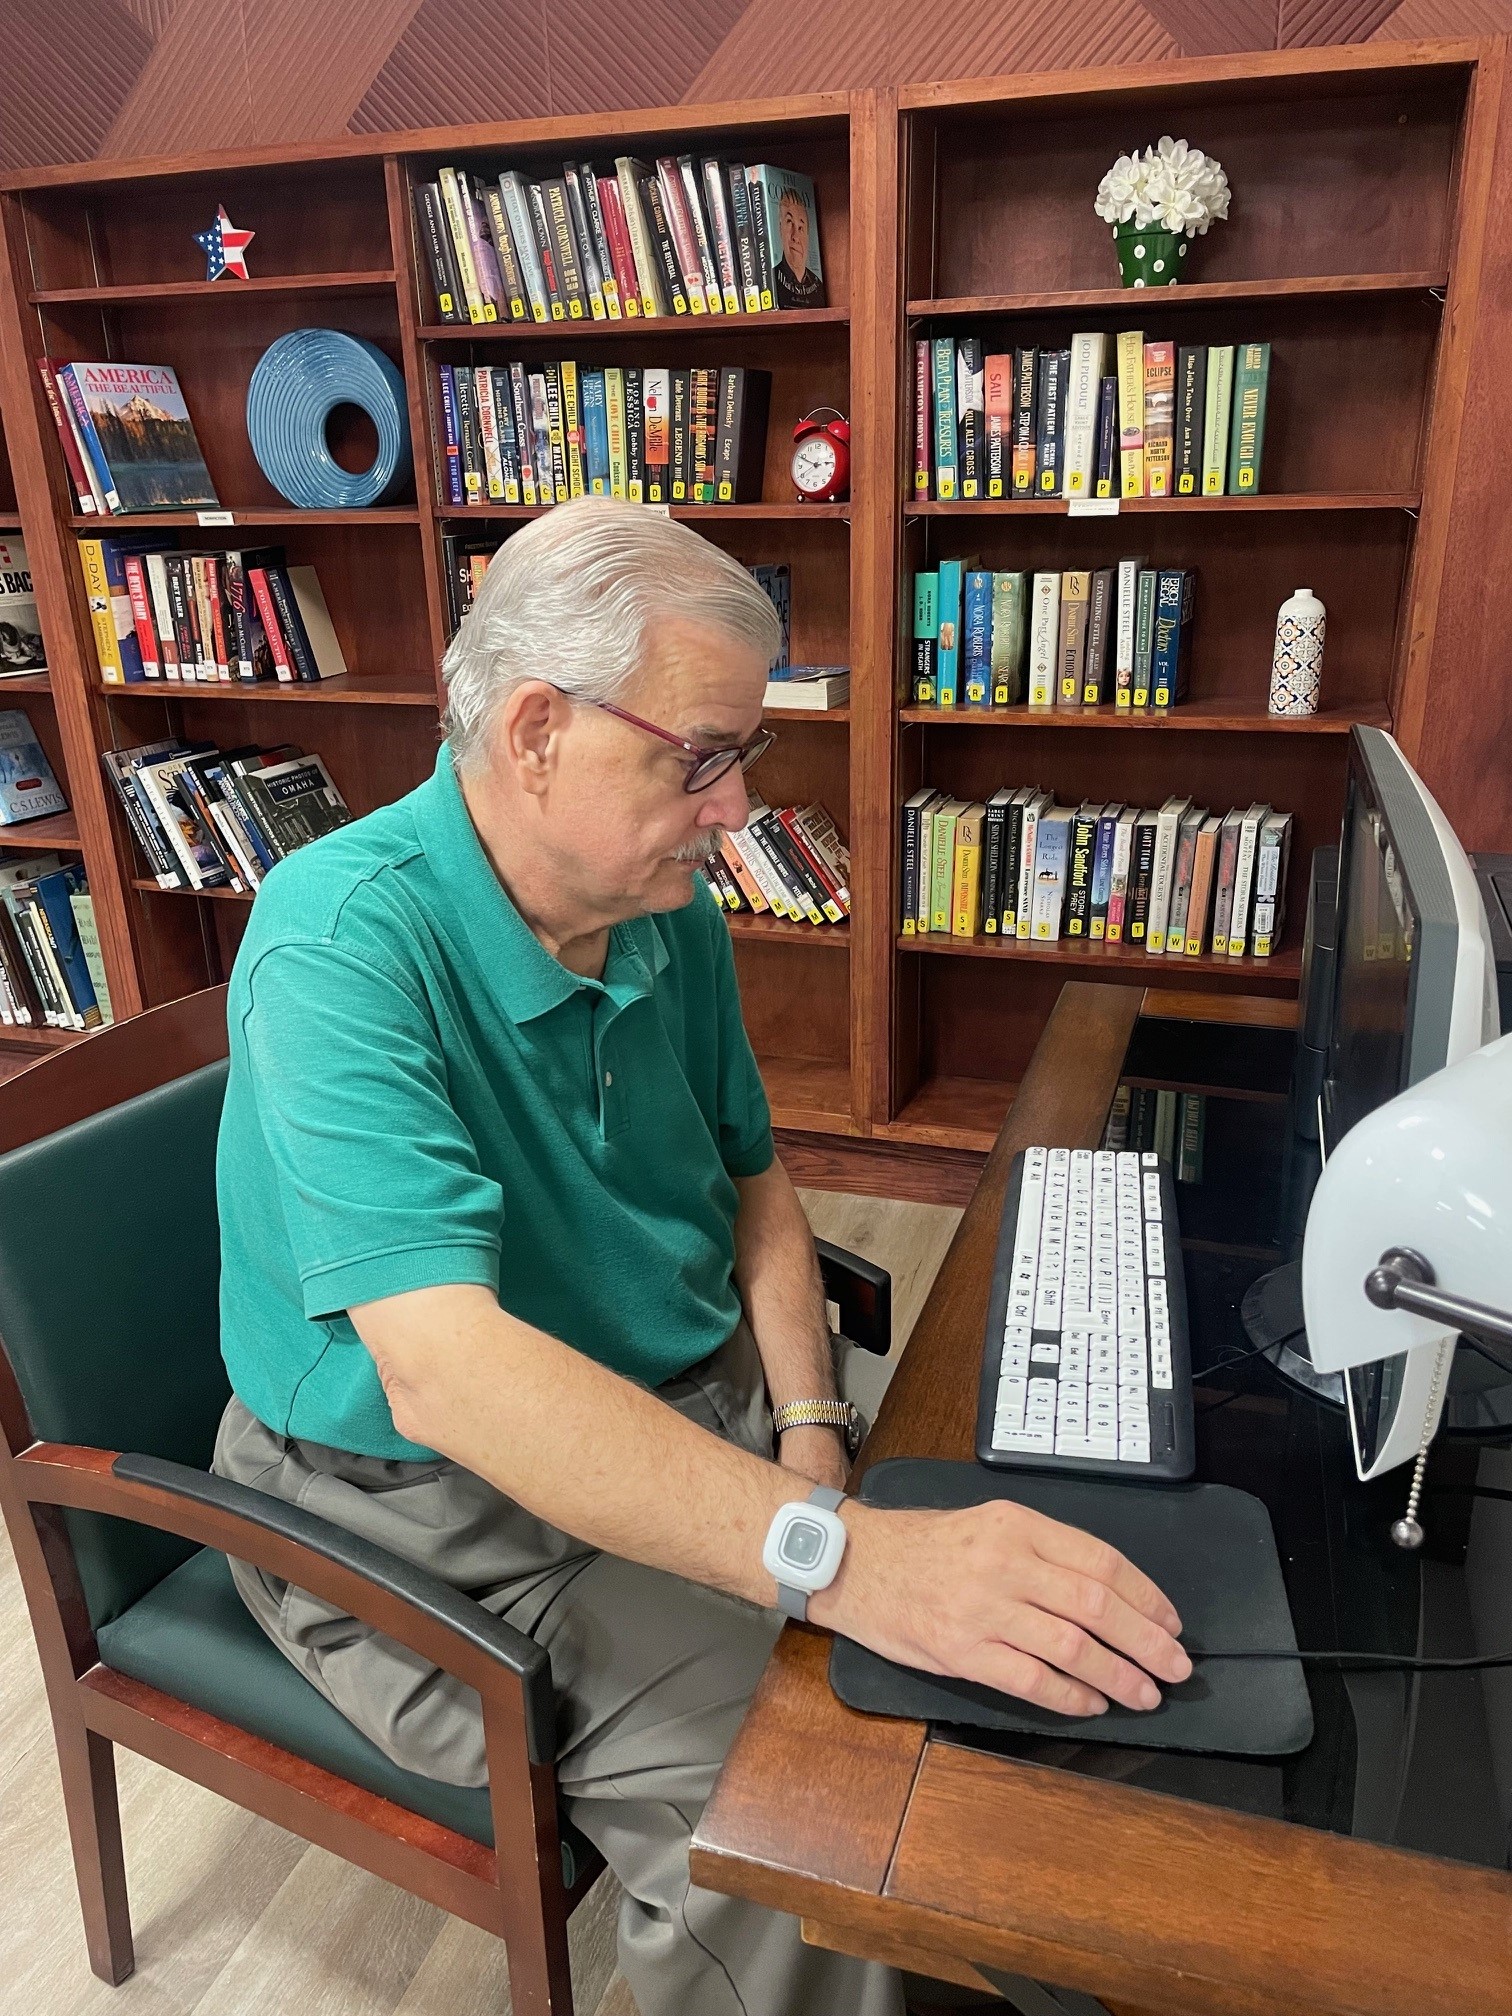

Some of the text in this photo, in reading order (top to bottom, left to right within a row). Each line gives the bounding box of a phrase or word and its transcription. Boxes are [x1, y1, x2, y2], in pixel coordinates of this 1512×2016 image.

[549, 187, 563, 223] PATRICIA
[556, 223, 572, 266] CORNWELL
[664, 252, 677, 280] REVERSAL
[741, 237, 753, 288] PARADO
[84, 367, 174, 385] AMERICA
[697, 371, 708, 386] KIRK
[1020, 351, 1033, 408] JAMES PATTERSON
[1078, 339, 1091, 410] JODI PICOULT
[1126, 336, 1137, 424] HER FATHER'S HOUSE
[1146, 366, 1172, 378] ECLIPSE
[1187, 369, 1195, 387] Julia
[40, 369, 52, 389] Inside
[51, 399, 63, 427] Vatican
[64, 372, 90, 427] AMERICA
[87, 384, 177, 395] THE BEAUTIFUL
[459, 383, 469, 416] Heretic
[547, 383, 560, 427] LEE CHILD
[565, 385, 576, 425] LEE CHILD
[594, 379, 603, 407] MARY
[626, 382, 635, 429] JESSICA
[696, 387, 708, 414] DOUGLAS
[916, 361, 924, 449] CRAMPTON HODNET
[937, 349, 953, 458] BELVA PLAIN TREASURES
[1047, 360, 1058, 435] THE FIRST PATIENT
[1186, 388, 1194, 406] Takes
[477, 370, 493, 444] PATRICIA CORNWELL
[513, 383, 526, 448] Southern Cross
[610, 399, 619, 421] LOVE
[649, 380, 663, 452] Neln DeMille
[674, 379, 684, 464] Jude Deveraux LEGEND
[723, 374, 736, 461] Barbara Delinsky Escape
[1185, 407, 1193, 423] Over
[612, 424, 620, 454] CHILD
[696, 418, 707, 430] THE
[990, 373, 1002, 474] SAIL JAMES PATTERSON
[1240, 388, 1259, 459] NEVER ENOUGH
[695, 431, 707, 459] RAGMAN'S
[965, 410, 975, 475] KILL ALEX CROSS
[1145, 454, 1170, 462] PATTERSON
[552, 446, 563, 487] MAKE ME
[613, 462, 621, 485] Cookson
[2, 571, 34, 593] BAC
[86, 545, 102, 593] D-DAY
[126, 562, 148, 621] THE DEVIL'S DIARY
[171, 576, 184, 618] BRET BAIER
[231, 581, 246, 613] 1776
[1042, 597, 1050, 615] One
[1122, 566, 1132, 634] DANIELLE STEEL
[1160, 578, 1170, 607] SEGAL
[1168, 578, 1180, 606] ERICH
[258, 590, 283, 664] FOUNDING MYTHS
[973, 604, 986, 626] NORA
[1092, 579, 1104, 647] STANDING STILL
[973, 626, 985, 657] ROBERTS
[1036, 627, 1050, 660] Angel
[1066, 602, 1079, 679] DANIELLE STEEL ECHOES
[1156, 616, 1176, 653] Doctors
[267, 775, 292, 789] HISTORIC
[291, 770, 311, 781] PHOTOS
[281, 779, 315, 795] OMAHA
[906, 809, 915, 847] DANIELLE
[937, 820, 948, 855] DANIELLE
[990, 824, 1000, 844] SIDNEY
[1010, 809, 1019, 843] NICHOLAS
[1045, 833, 1058, 842] The
[765, 845, 779, 864] TERRIBLE
[777, 862, 790, 878] HOURS
[906, 848, 914, 871] STEEL
[936, 857, 948, 880] STEEL
[989, 845, 1000, 872] SHELDON
[1009, 845, 1017, 871] SPARKS
[1073, 822, 1094, 887] John Sandford
[1160, 834, 1169, 875] ACCIDENTAL
[1070, 892, 1078, 913] PREY
[1077, 890, 1086, 916] STORM
[1101, 1153, 1112, 1162] Tab
[1021, 1254, 1033, 1265] Alt
[1015, 1305, 1028, 1318] Ctrl
[1044, 1290, 1056, 1306] Shift
[1101, 1309, 1112, 1326] Enter
